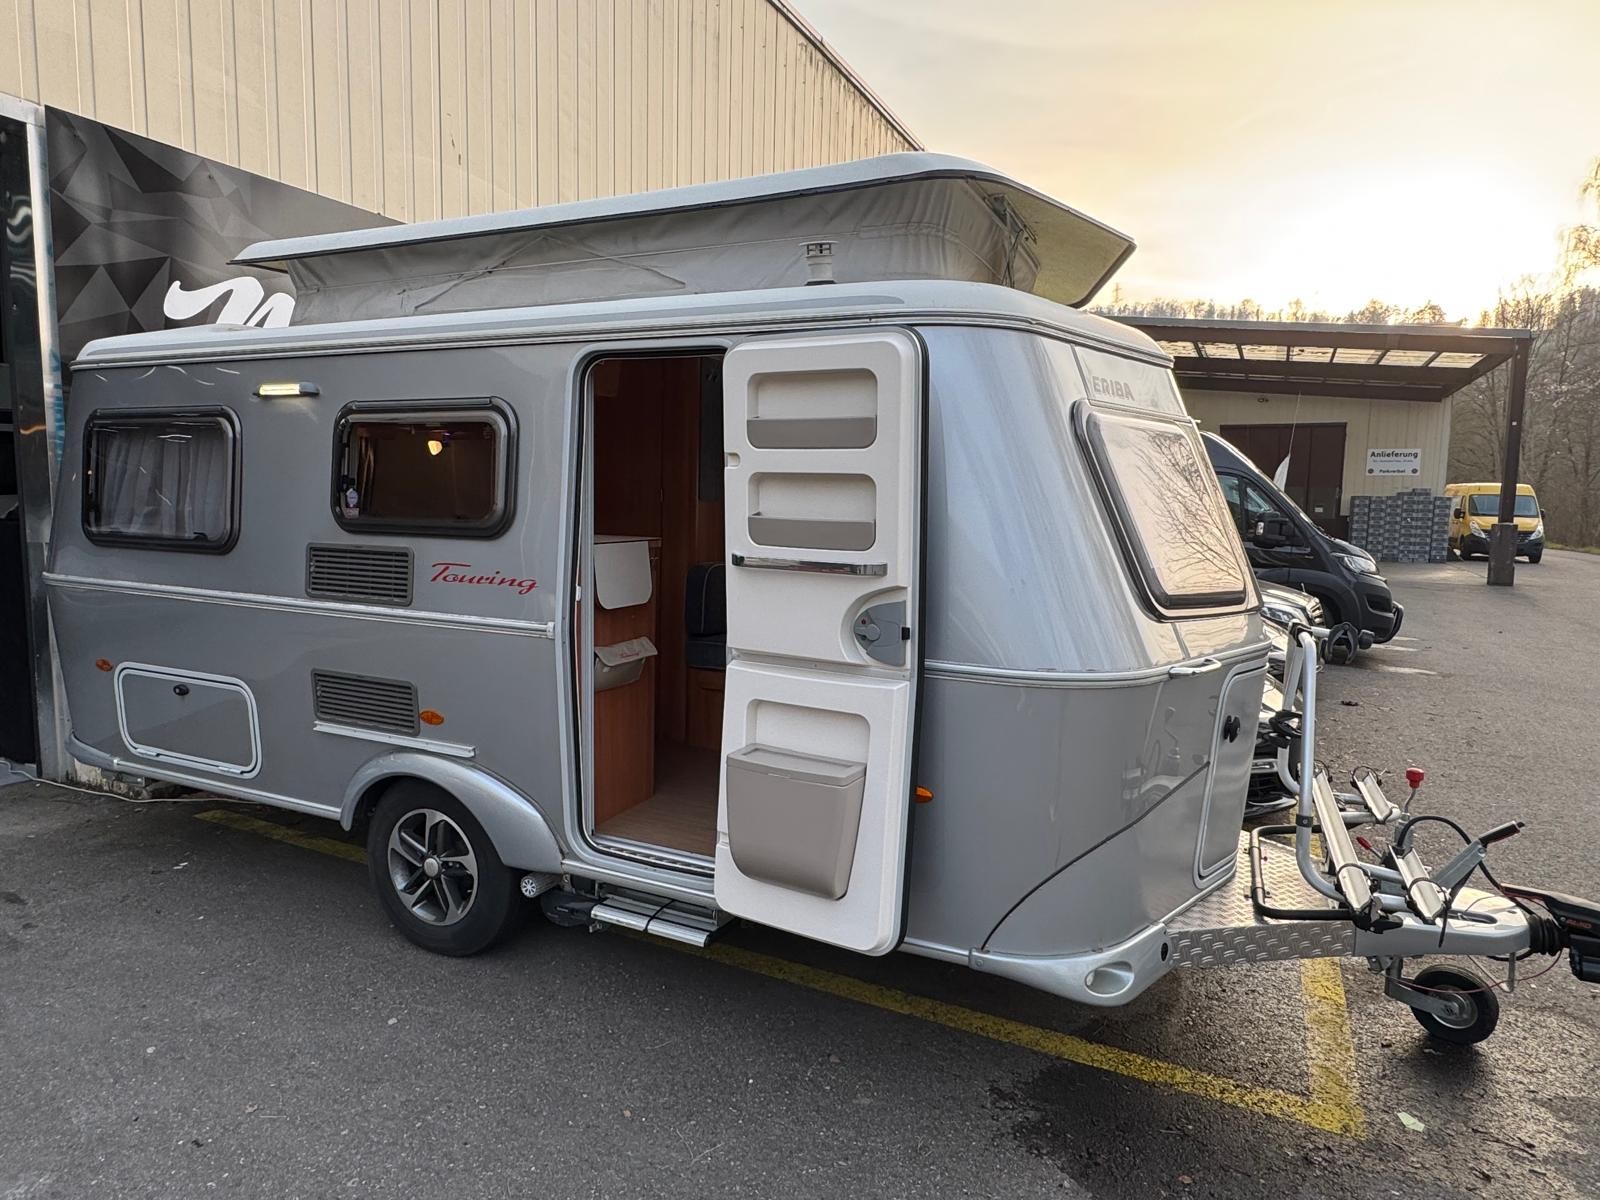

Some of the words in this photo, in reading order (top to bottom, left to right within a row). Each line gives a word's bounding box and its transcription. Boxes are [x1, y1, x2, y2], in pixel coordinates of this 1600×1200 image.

[1091, 375, 1135, 401] ERIBA
[1370, 451, 1419, 459] Anlieferung
[430, 563, 539, 596] Touring
